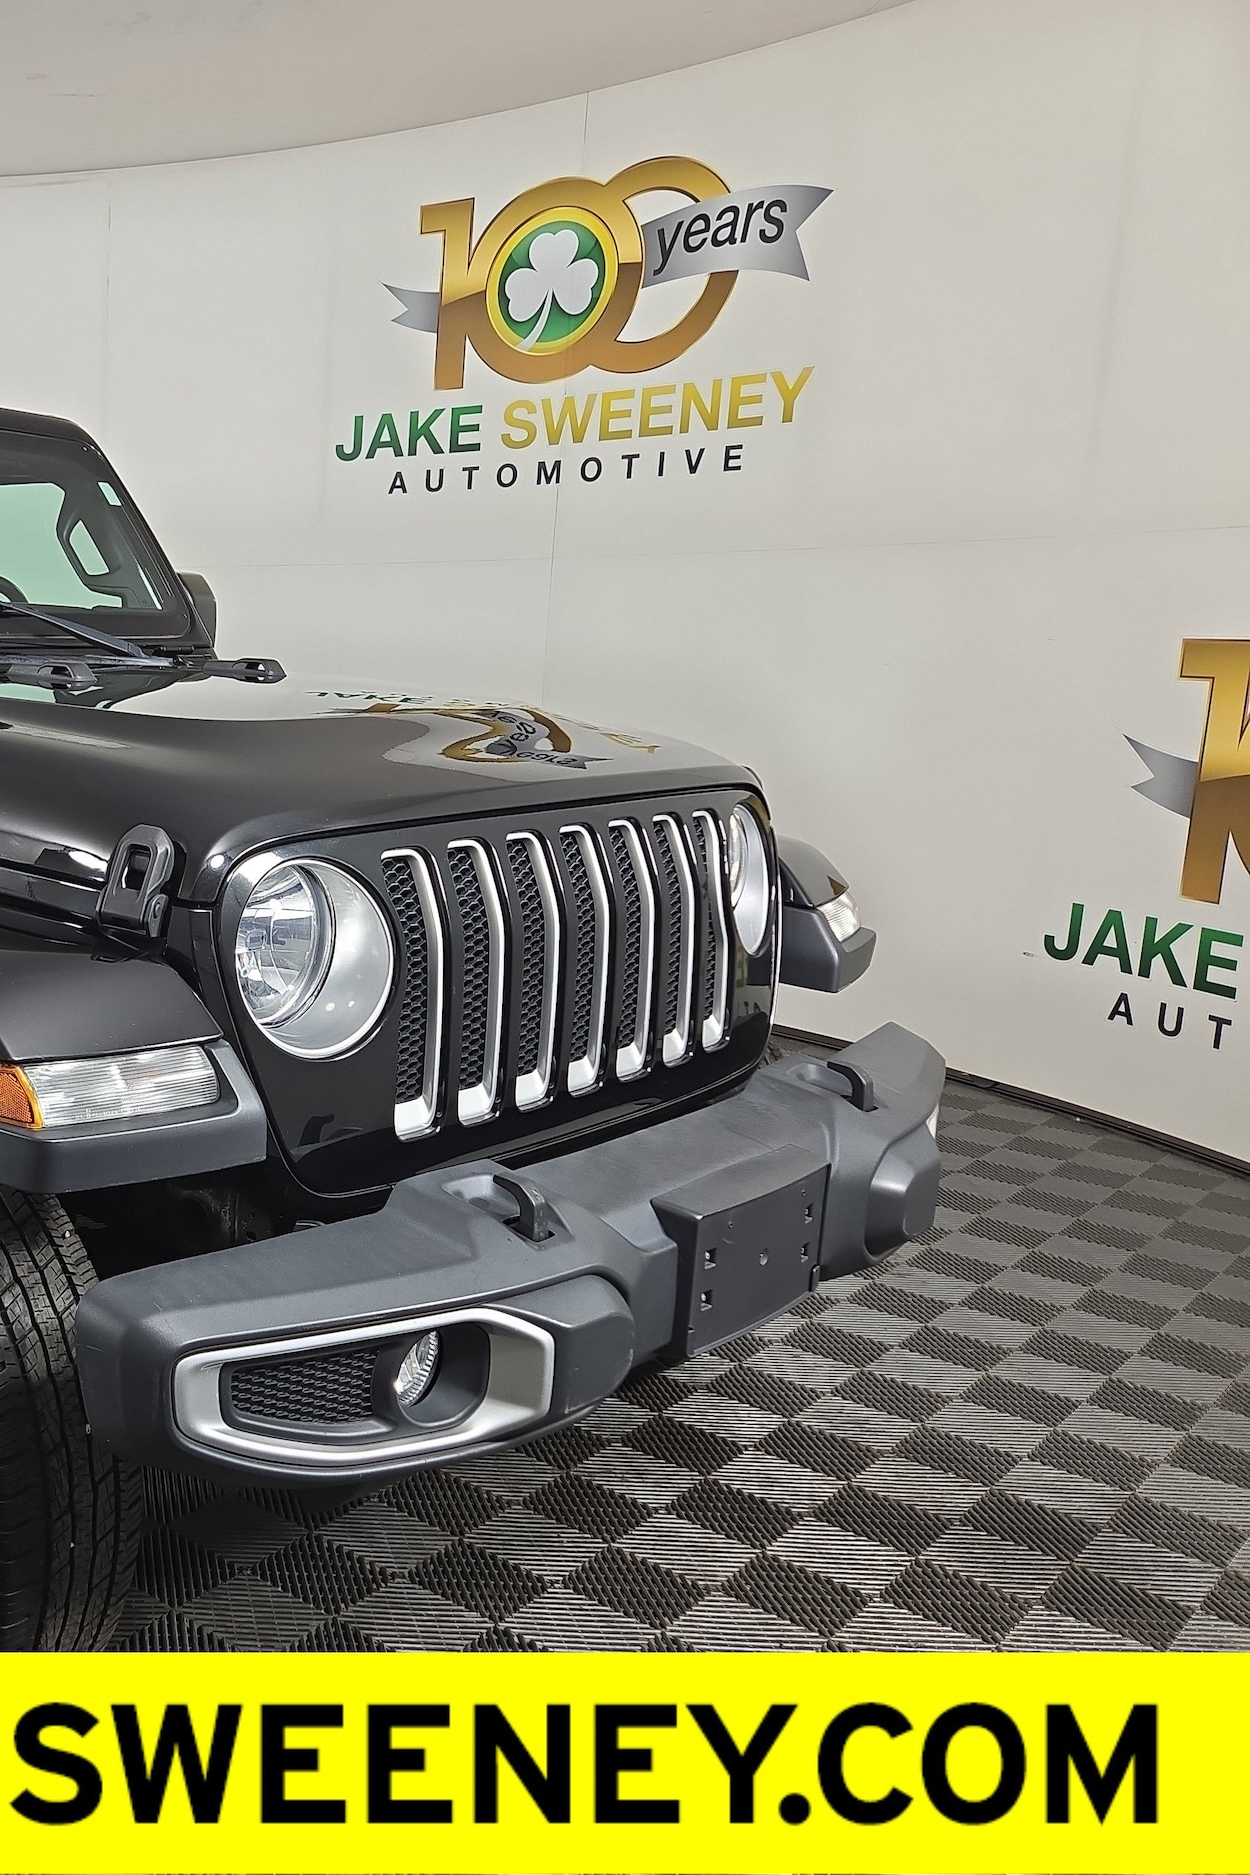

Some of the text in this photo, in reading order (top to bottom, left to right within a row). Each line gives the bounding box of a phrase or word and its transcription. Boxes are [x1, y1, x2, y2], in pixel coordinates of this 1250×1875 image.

[652, 198, 788, 277] years
[335, 365, 816, 462] JAKE SWEENEY
[388, 444, 744, 495] AUTOMOTIVE
[1043, 901, 1245, 1001] JAKE
